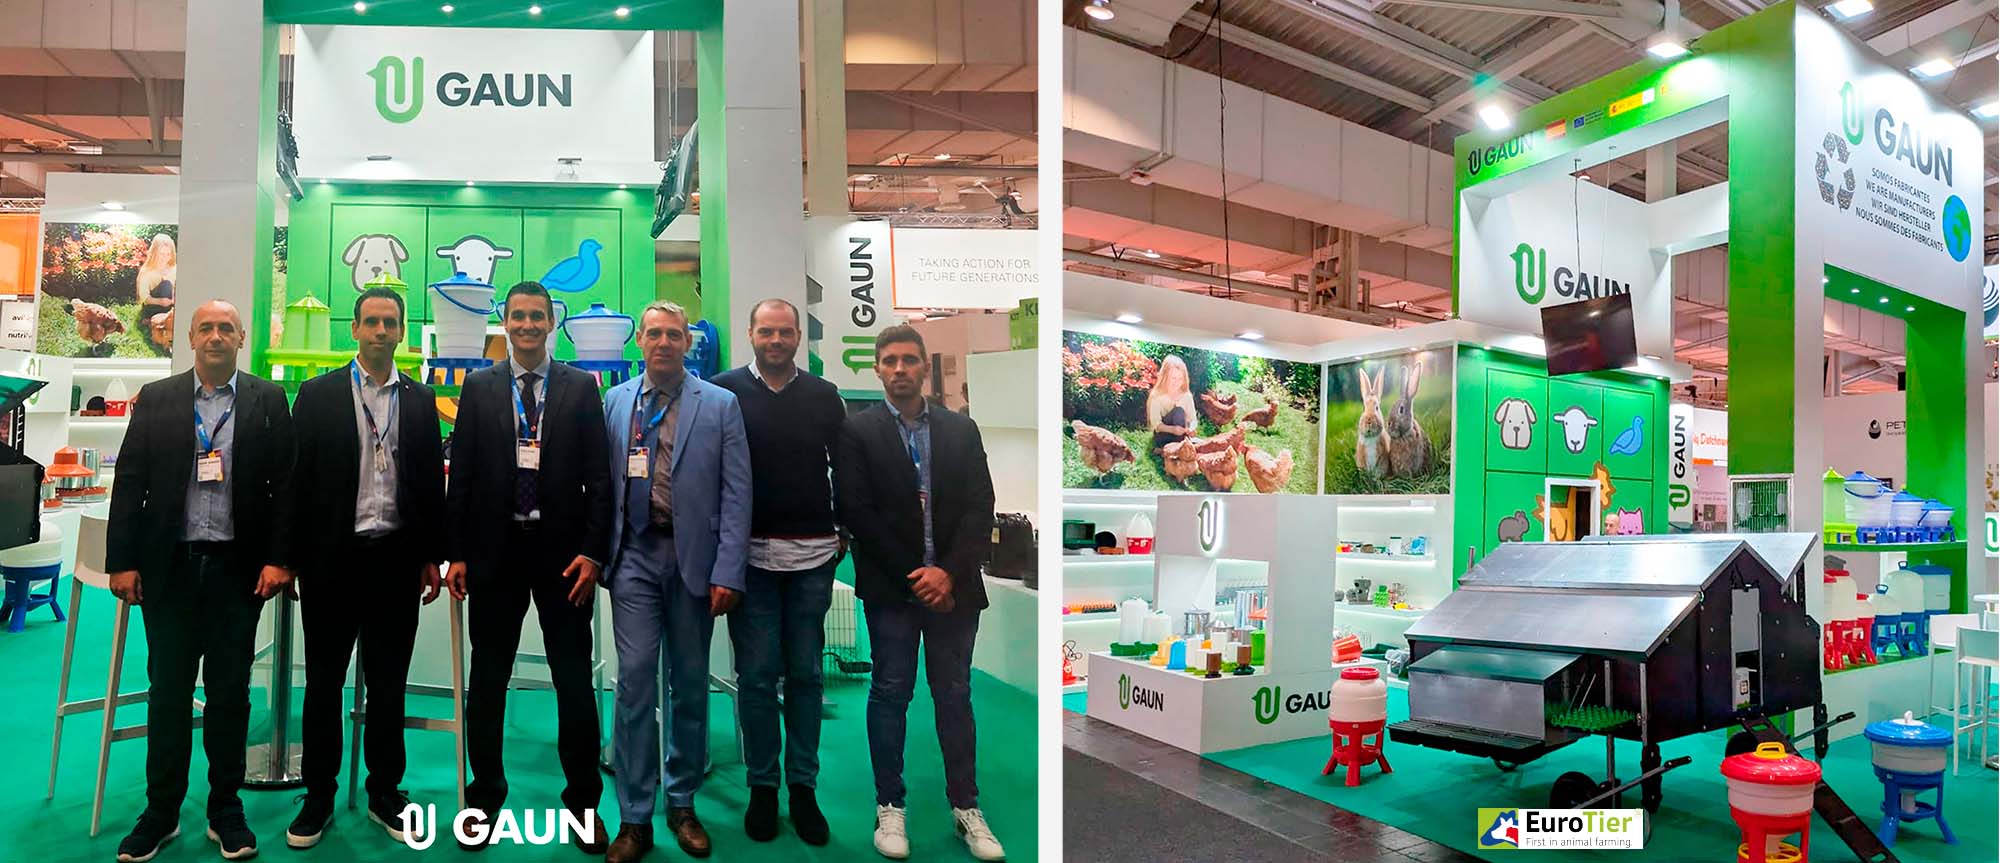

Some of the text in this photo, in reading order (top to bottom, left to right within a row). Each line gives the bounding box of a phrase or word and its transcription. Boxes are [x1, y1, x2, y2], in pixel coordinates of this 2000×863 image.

[436, 72, 572, 107] GAUN
[1485, 131, 1534, 166] GAUN
[1874, 108, 1952, 187] GAUN
[1865, 179, 1936, 220] WE ARE MANUFACTURERS
[1871, 167, 1930, 203] SOMOS FABRICANTES
[1855, 206, 1944, 252] NOUS SOMMES DES FABRICANTS
[1871, 197, 1931, 232] WIR SIND HERSTELLER
[912, 272, 1039, 283] FUTURE GENERATIONS
[919, 258, 1031, 269] TAKING ACTION FOR
[849, 237, 876, 328] GAUN
[1674, 415, 1686, 478] GAUN
[1132, 685, 1164, 712] GAUN
[1285, 691, 1331, 714] GAU
